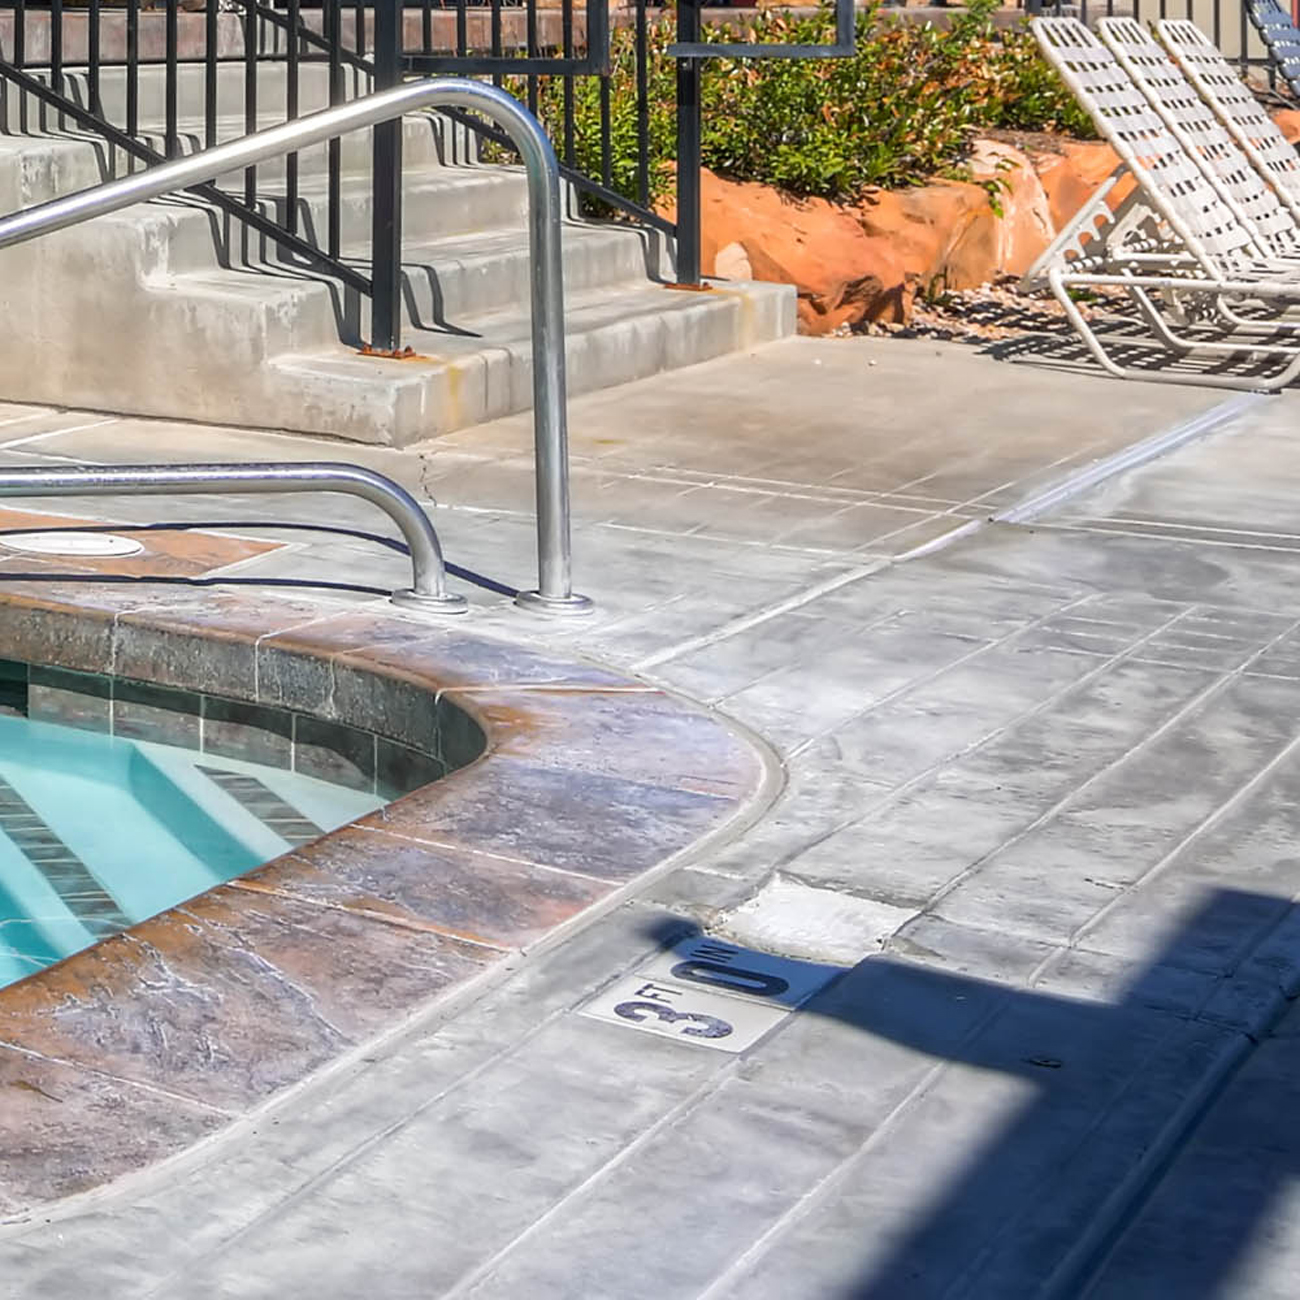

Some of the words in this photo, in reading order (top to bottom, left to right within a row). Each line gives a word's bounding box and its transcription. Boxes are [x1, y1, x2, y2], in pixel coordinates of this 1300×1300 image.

[689, 943, 740, 964] IN
[634, 982, 684, 1005] FT
[670, 960, 789, 997] 0
[613, 1000, 734, 1039] 3
